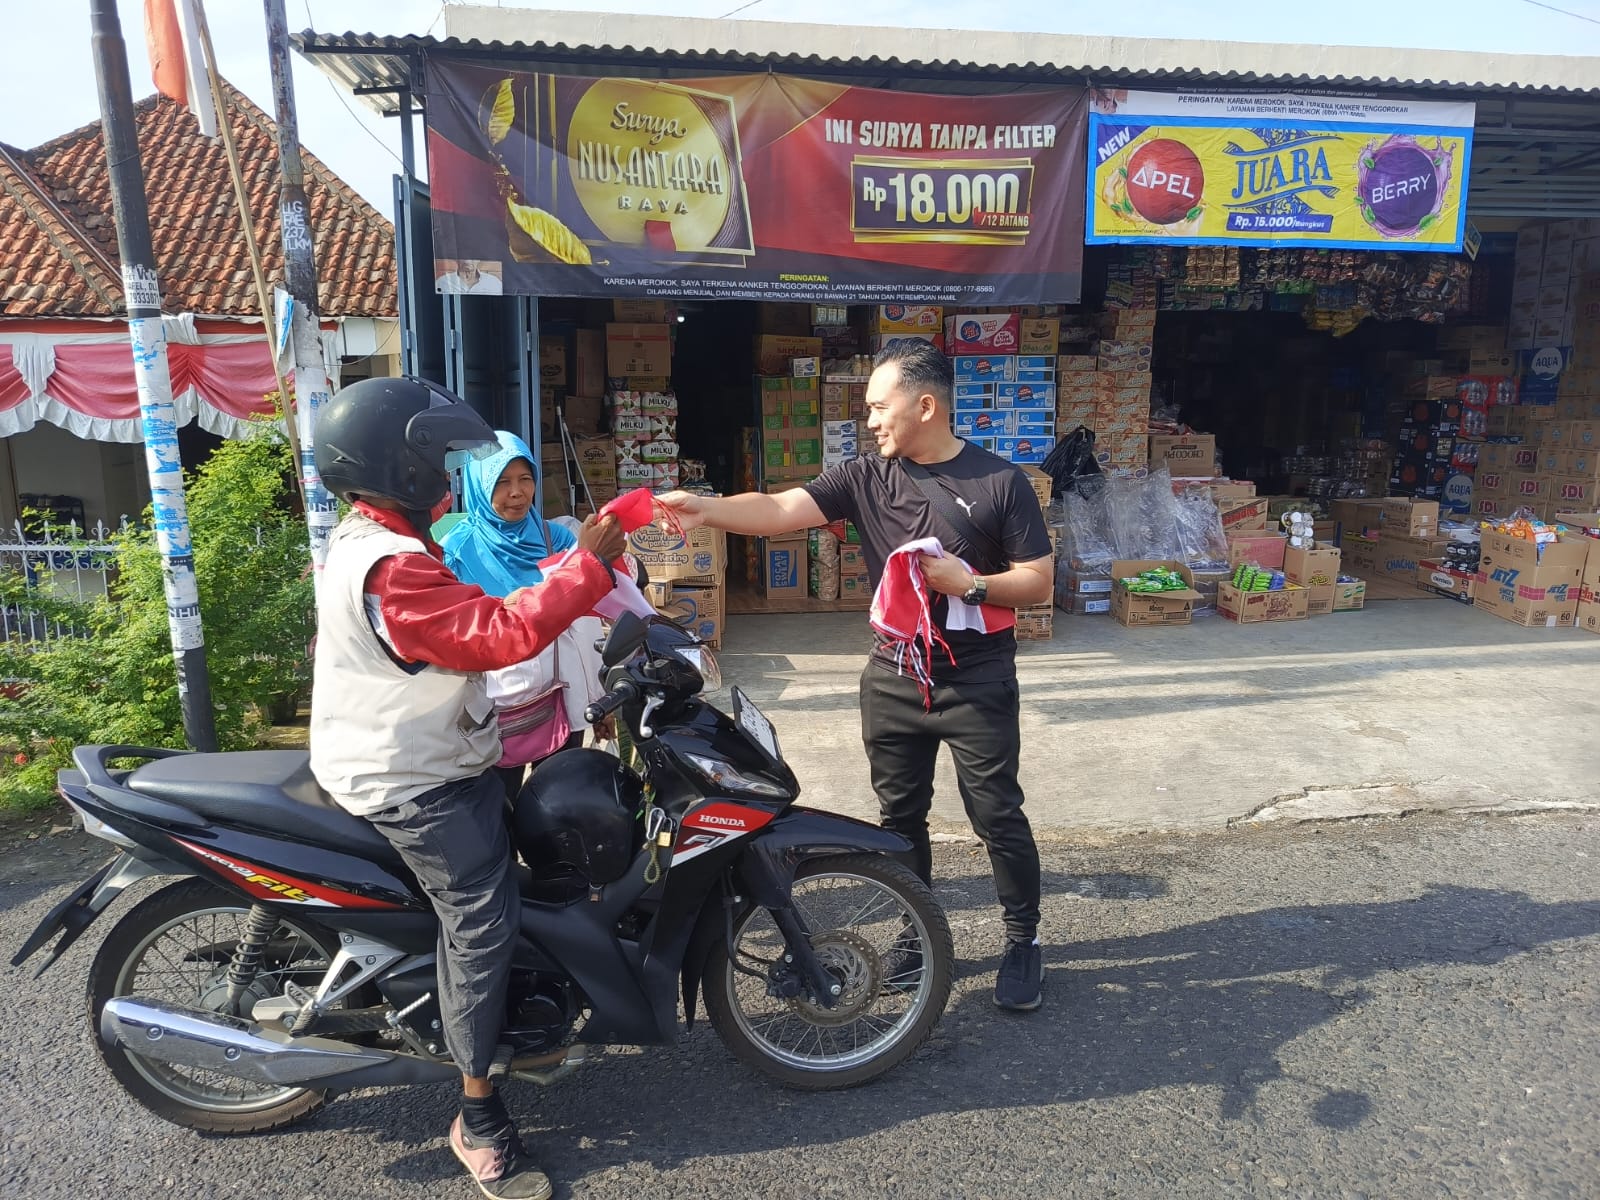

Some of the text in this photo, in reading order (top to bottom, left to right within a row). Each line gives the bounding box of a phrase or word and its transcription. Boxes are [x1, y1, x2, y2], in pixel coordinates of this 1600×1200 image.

[1228, 97, 1253, 105] KARENA
[1335, 103, 1360, 111] KANKER
[1362, 105, 1409, 113] TENGGOROKAN
[1256, 106, 1287, 114] BERHENTI
[1288, 107, 1320, 116] MEROKOK
[611, 100, 688, 145] Surya
[825, 117, 1057, 151] INI SURYA TANPA FILTER
[1098, 127, 1131, 159] NEW
[577, 139, 724, 197] NUSANTARA
[1231, 146, 1333, 199] JUARA
[1131, 165, 1195, 199] APEL
[1371, 173, 1431, 204] BERRY
[617, 194, 689, 216] RAYA
[862, 173, 1020, 224] Rp 18.000
[998, 213, 1030, 228] BATANG
[1235, 216, 1252, 229] Rp.
[284, 226, 306, 240] 237
[779, 273, 830, 283] PERINGATAN:
[603, 278, 636, 286] KARENA
[680, 279, 700, 288] SAYA
[702, 280, 737, 288] TERKENA
[738, 281, 769, 289] KANKER
[866, 284, 904, 292] BERHENTI
[905, 285, 942, 293] MEROKOK
[647, 288, 682, 296] DILARANG
[683, 289, 714, 297] MENJUAL
[731, 290, 763, 298] MEMBERI
[763, 291, 790, 299] KEPADA
[1535, 356, 1558, 368] AQUA
[648, 397, 671, 407] MILKU
[620, 420, 644, 429] MILKU
[650, 446, 673, 455] MILKU
[626, 469, 649, 477] MILKU
[1448, 485, 1471, 497] AQUA
[658, 552, 689, 564] Kering
[1560, 612, 1571, 621] 60
[698, 814, 746, 827] HONDA
